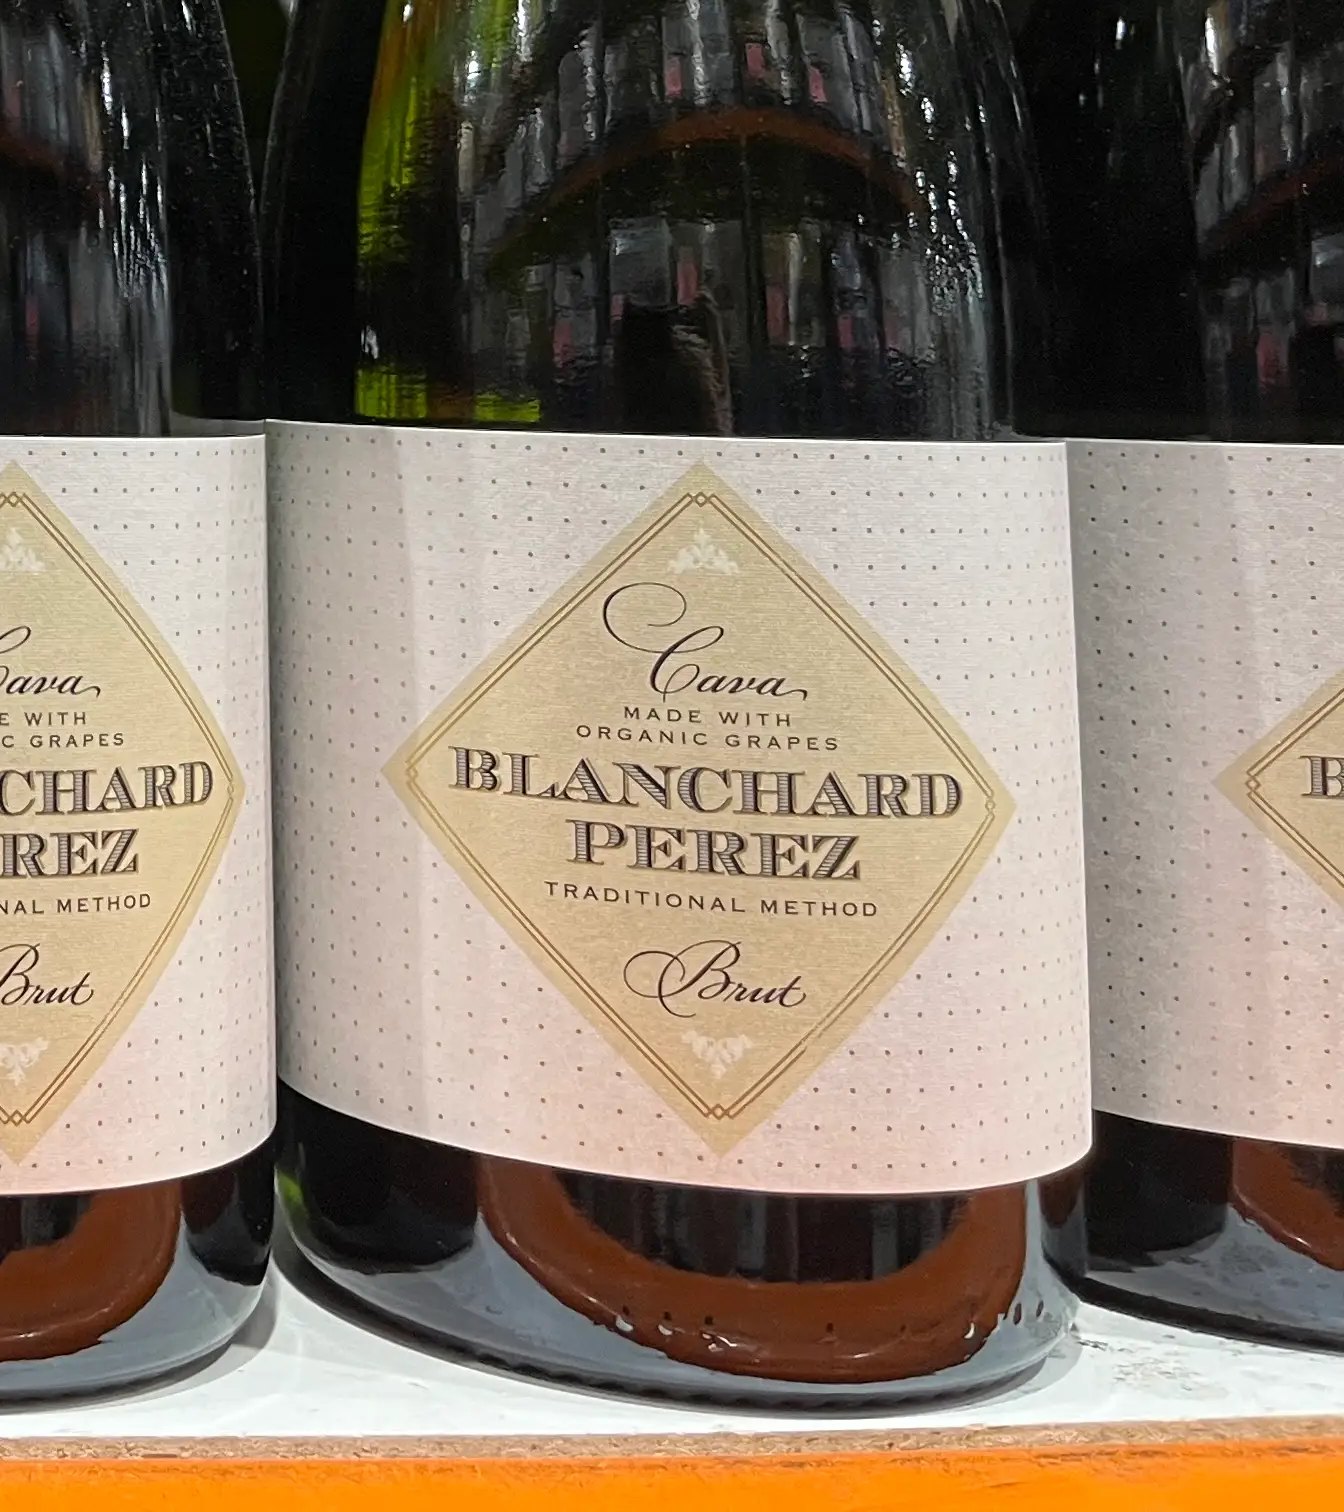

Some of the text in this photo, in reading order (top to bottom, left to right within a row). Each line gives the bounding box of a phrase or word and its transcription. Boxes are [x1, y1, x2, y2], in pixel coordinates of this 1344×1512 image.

[602, 582, 808, 702] Cava
[23, 710, 88, 727] WITH
[623, 706, 792, 728] MADE WITH
[28, 732, 125, 748] GRAPES
[576, 724, 839, 752] ORGANIC GRAPES
[447, 745, 963, 819] BLANCHARD
[565, 818, 862, 881] PEREZ
[56, 893, 151, 914] METHOD
[544, 880, 878, 918] TRADITIONAL METHOD
[622, 939, 806, 1018] Brut
